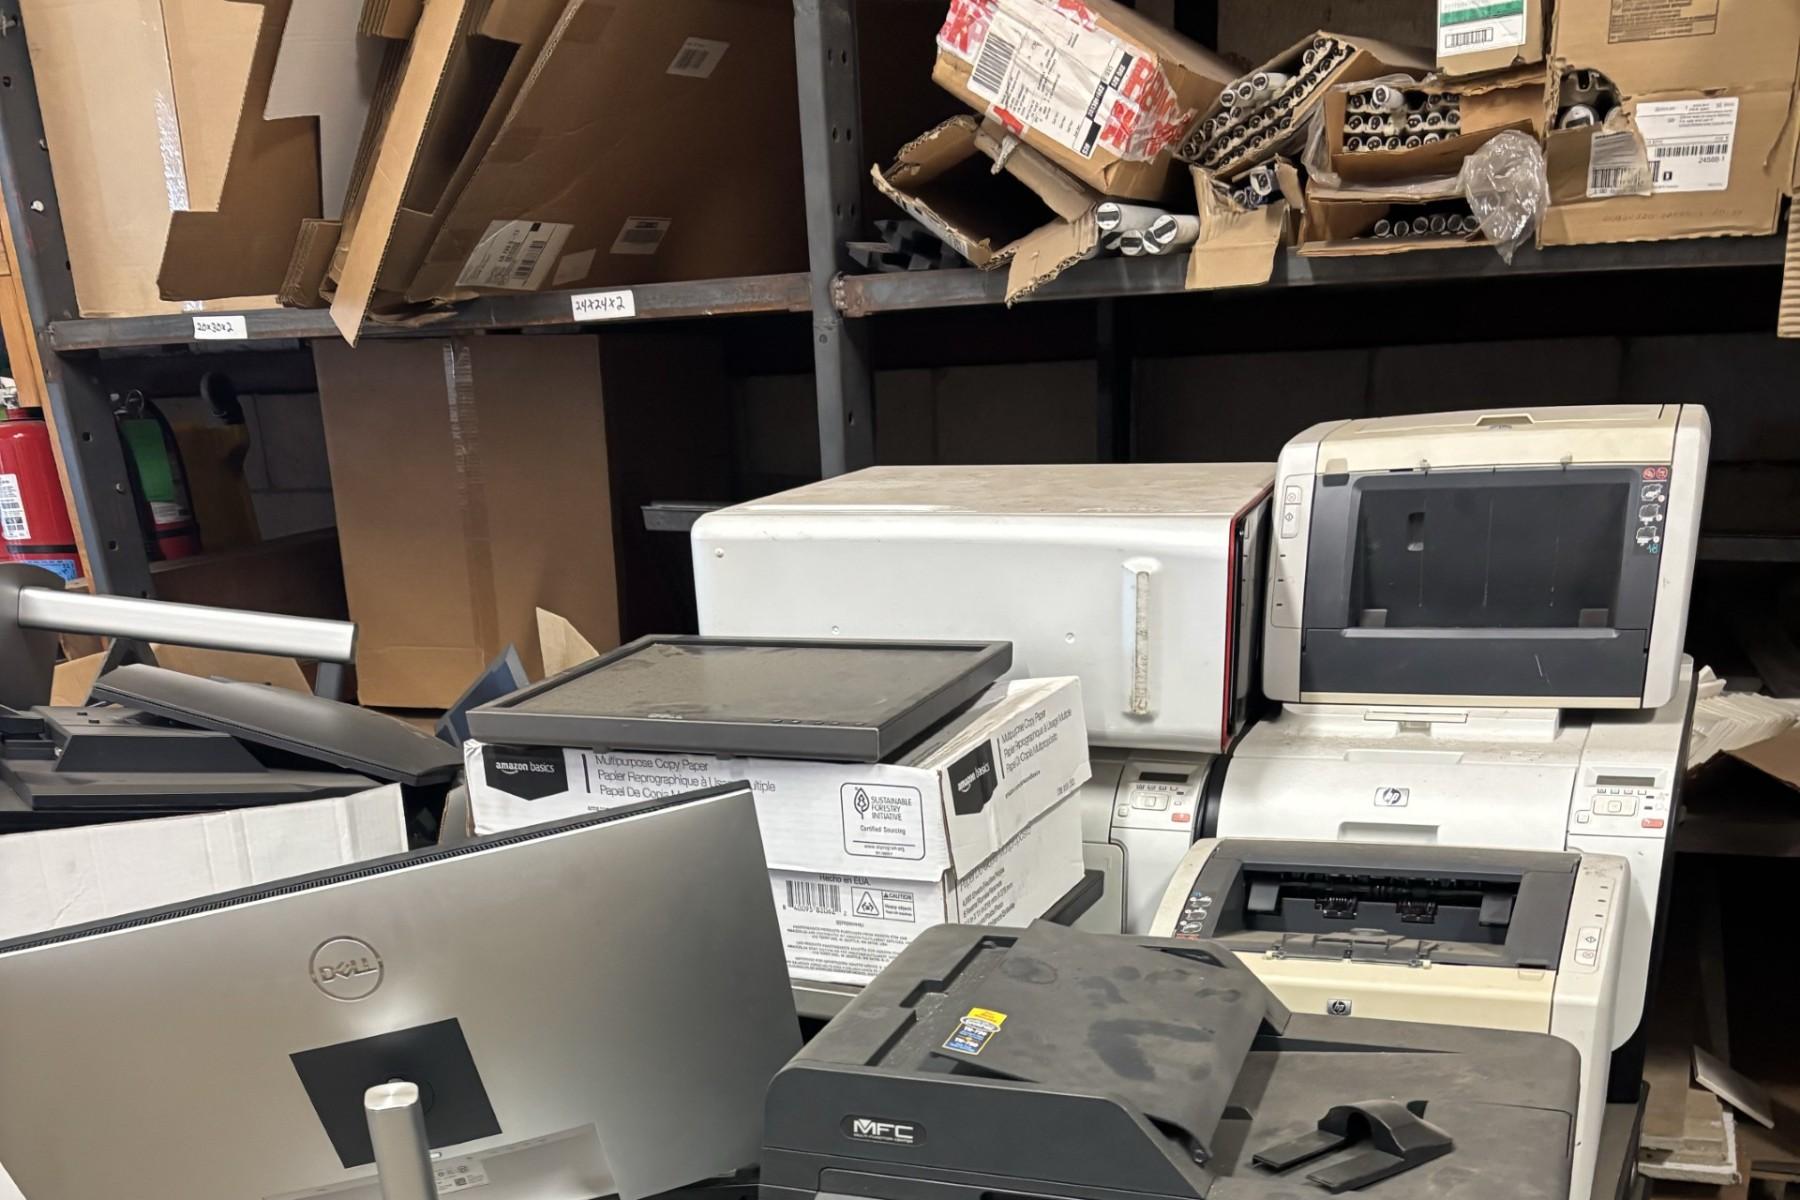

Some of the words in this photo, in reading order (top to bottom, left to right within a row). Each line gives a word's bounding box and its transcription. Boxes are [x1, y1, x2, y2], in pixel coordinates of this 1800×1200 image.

[495, 761, 529, 773] amazon
[530, 761, 555, 773] basics
[595, 754, 654, 770] Multipurpose
[655, 757, 681, 773] Copy
[682, 760, 708, 773] Paper
[598, 770, 626, 784] Papier
[627, 772, 698, 788] Reprographique
[599, 784, 627, 798] Papel
[628, 786, 641, 797] De
[870, 796, 912, 806] SUSTAINABLE
[871, 804, 901, 813] FORESTRY
[318, 957, 379, 984] DELL
[853, 1118, 914, 1139] MFC
